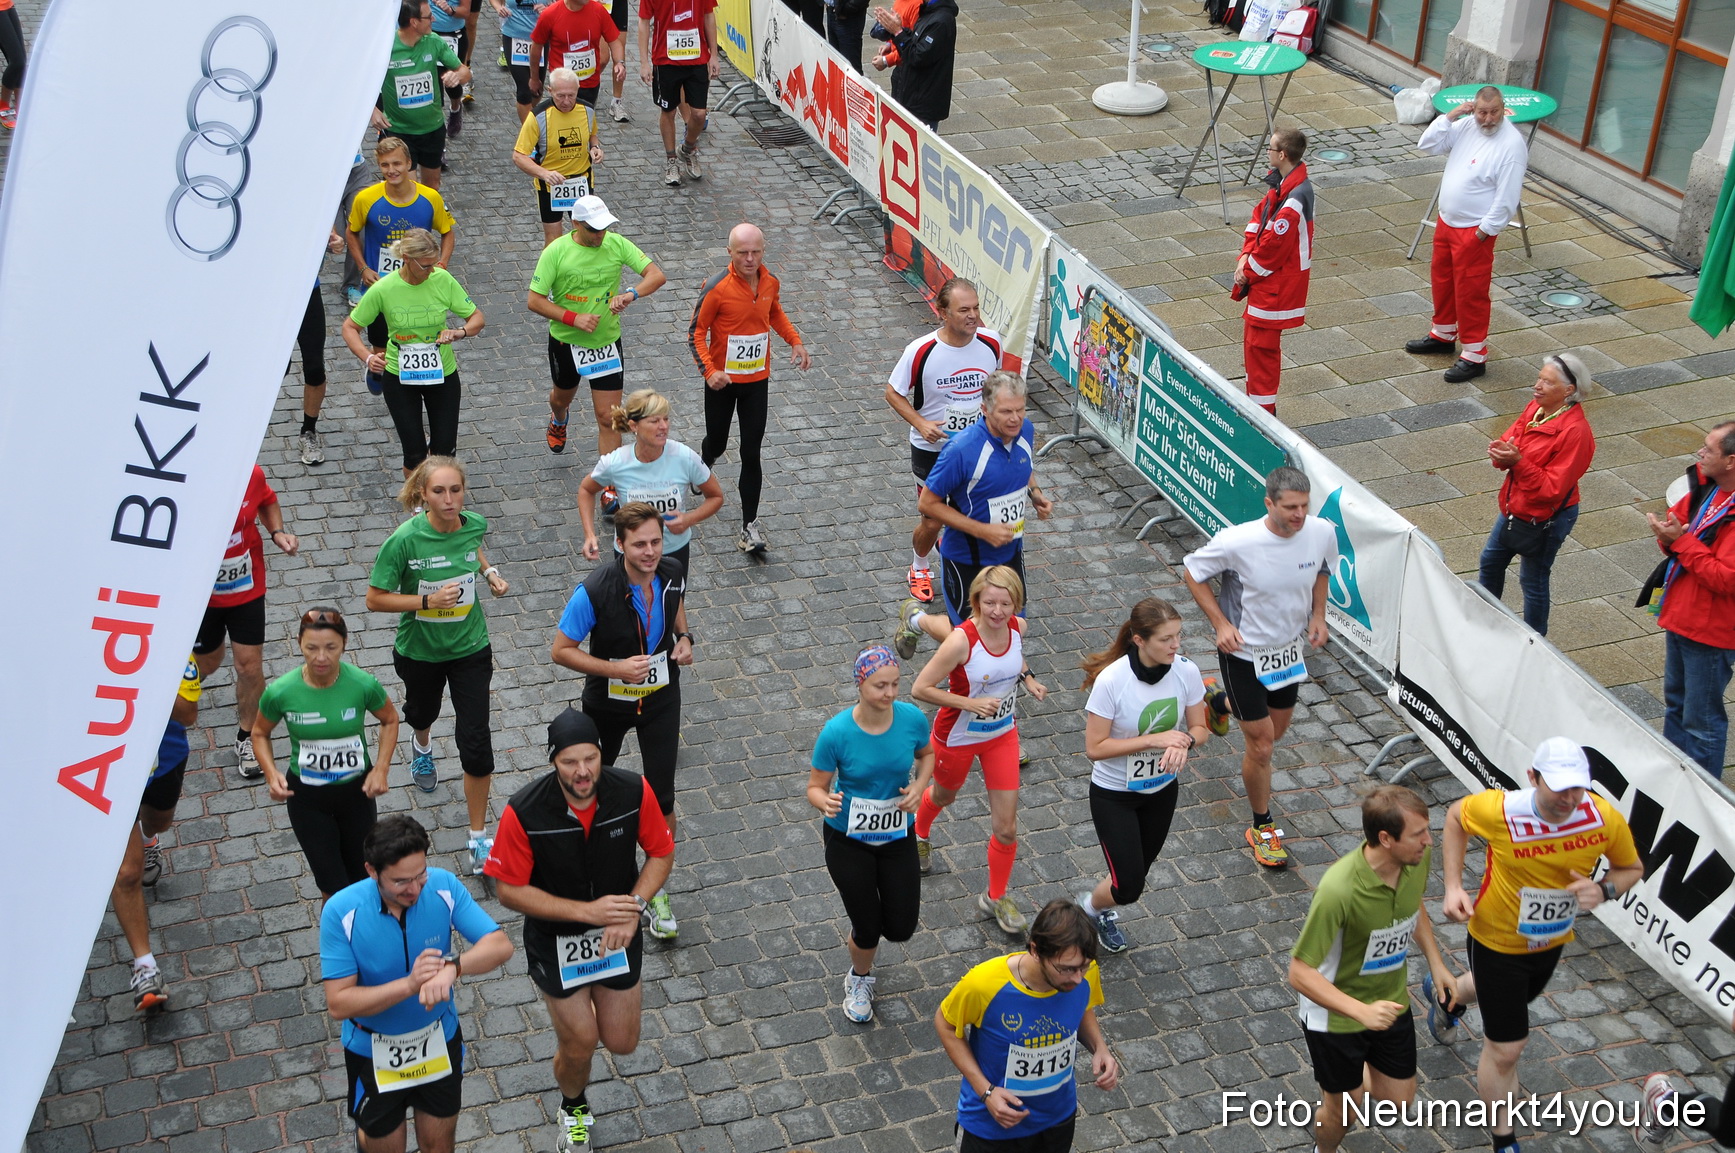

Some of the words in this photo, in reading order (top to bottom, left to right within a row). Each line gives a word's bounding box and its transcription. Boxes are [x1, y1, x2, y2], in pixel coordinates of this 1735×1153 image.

[675, 38, 694, 48] 155
[571, 58, 591, 70] 253
[401, 81, 430, 97] 2729
[827, 109, 847, 147] Braun
[554, 186, 586, 198] 2816
[403, 353, 438, 369] 2383
[578, 345, 615, 364] 2382
[736, 344, 761, 360] 246
[590, 365, 608, 373] Benno
[937, 374, 980, 386] GERHART
[1166, 370, 1235, 438] Event-Leit-Systeme
[1144, 392, 1175, 432] Mehr
[1176, 421, 1236, 488] Sicherheit
[1142, 417, 1160, 447] für
[1161, 433, 1178, 463] Ihr
[1179, 452, 1218, 500] Event!
[1139, 452, 1156, 477] Miet
[1156, 469, 1163, 483] &
[1163, 474, 1189, 507] Service
[1189, 500, 1206, 524] Line:
[1207, 514, 1223, 532] 091
[1000, 500, 1024, 523] 332
[57, 587, 161, 815] Audi
[110, 340, 211, 550] BKK
[438, 609, 454, 617] Sina
[1351, 624, 1372, 647] GmbH
[1260, 646, 1298, 672] 2566
[1399, 685, 1446, 735] istungen,
[1446, 729, 1461, 749] die
[306, 750, 358, 771] 2046
[855, 809, 903, 831] 2800
[860, 833, 893, 841] Melanie
[1513, 845, 1557, 859] MAX
[1563, 832, 1609, 852] BÖGL
[577, 960, 611, 975] Michael
[396, 1027, 433, 1044] Neumarkt
[389, 1037, 429, 1068] 327
[1010, 1049, 1032, 1058] PARTL
[399, 1065, 428, 1079] Bernd
[1014, 1049, 1071, 1078] 3413
